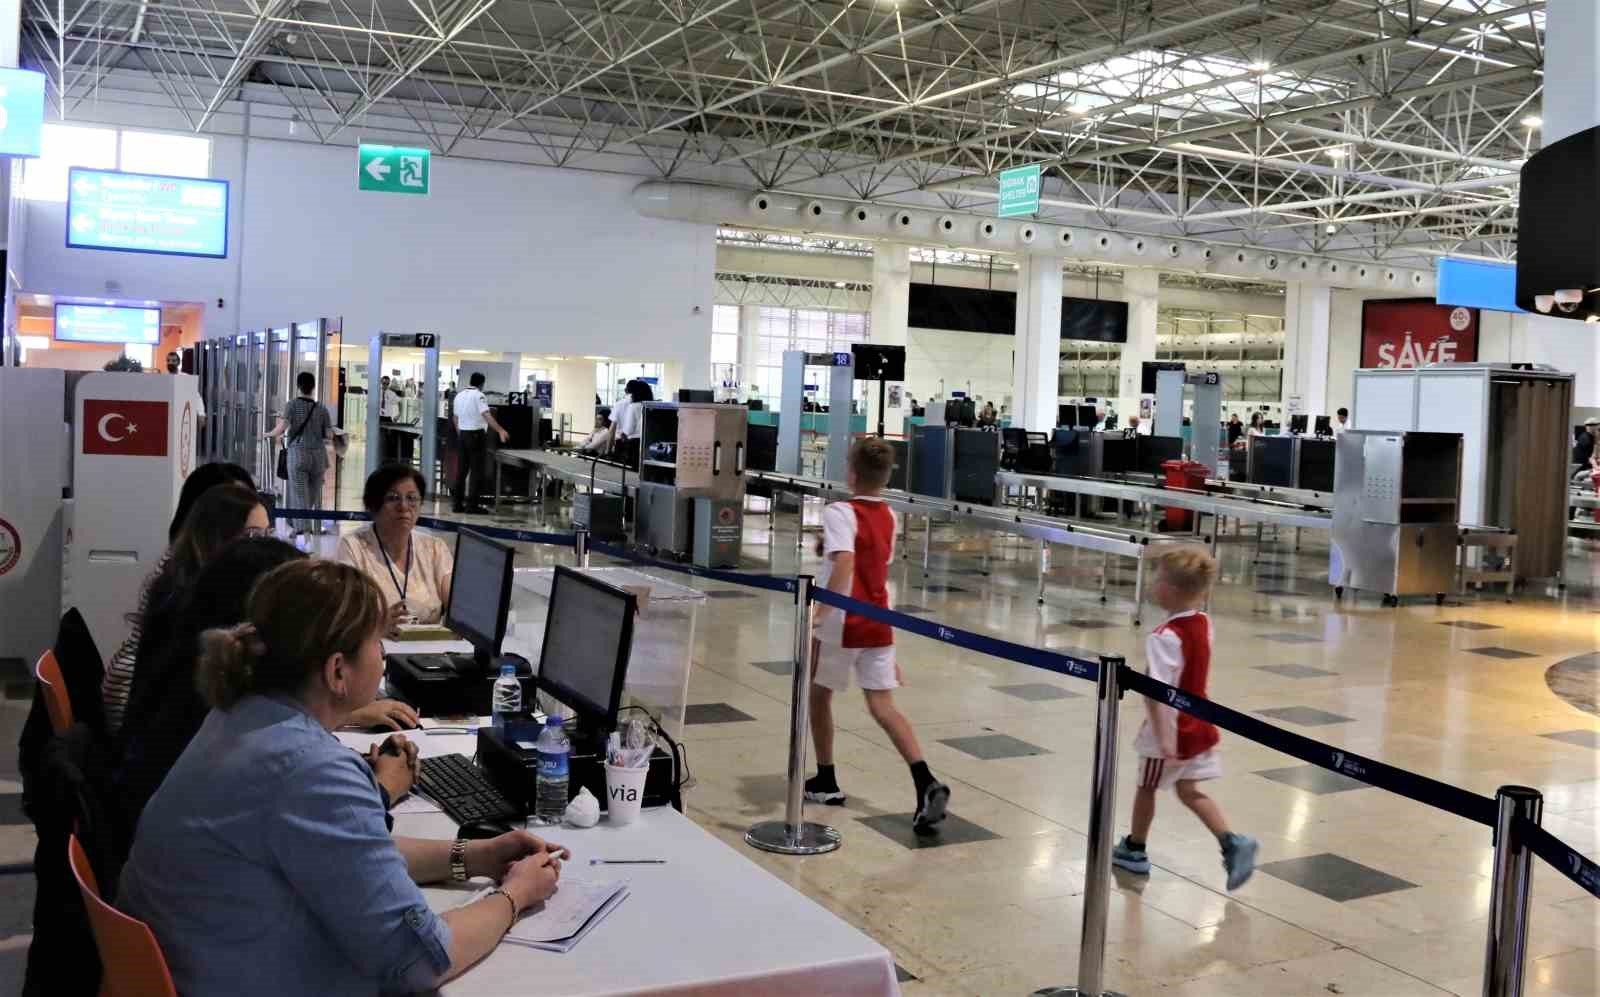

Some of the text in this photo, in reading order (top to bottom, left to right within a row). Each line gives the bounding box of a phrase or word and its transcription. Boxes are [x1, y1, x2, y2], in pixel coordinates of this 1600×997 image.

[418, 334, 432, 347] 17
[836, 353, 848, 365] 18
[1207, 373, 1217, 384] 19
[511, 392, 526, 405] 21
[1125, 428, 1136, 440] 24
[610, 784, 638, 802] via
